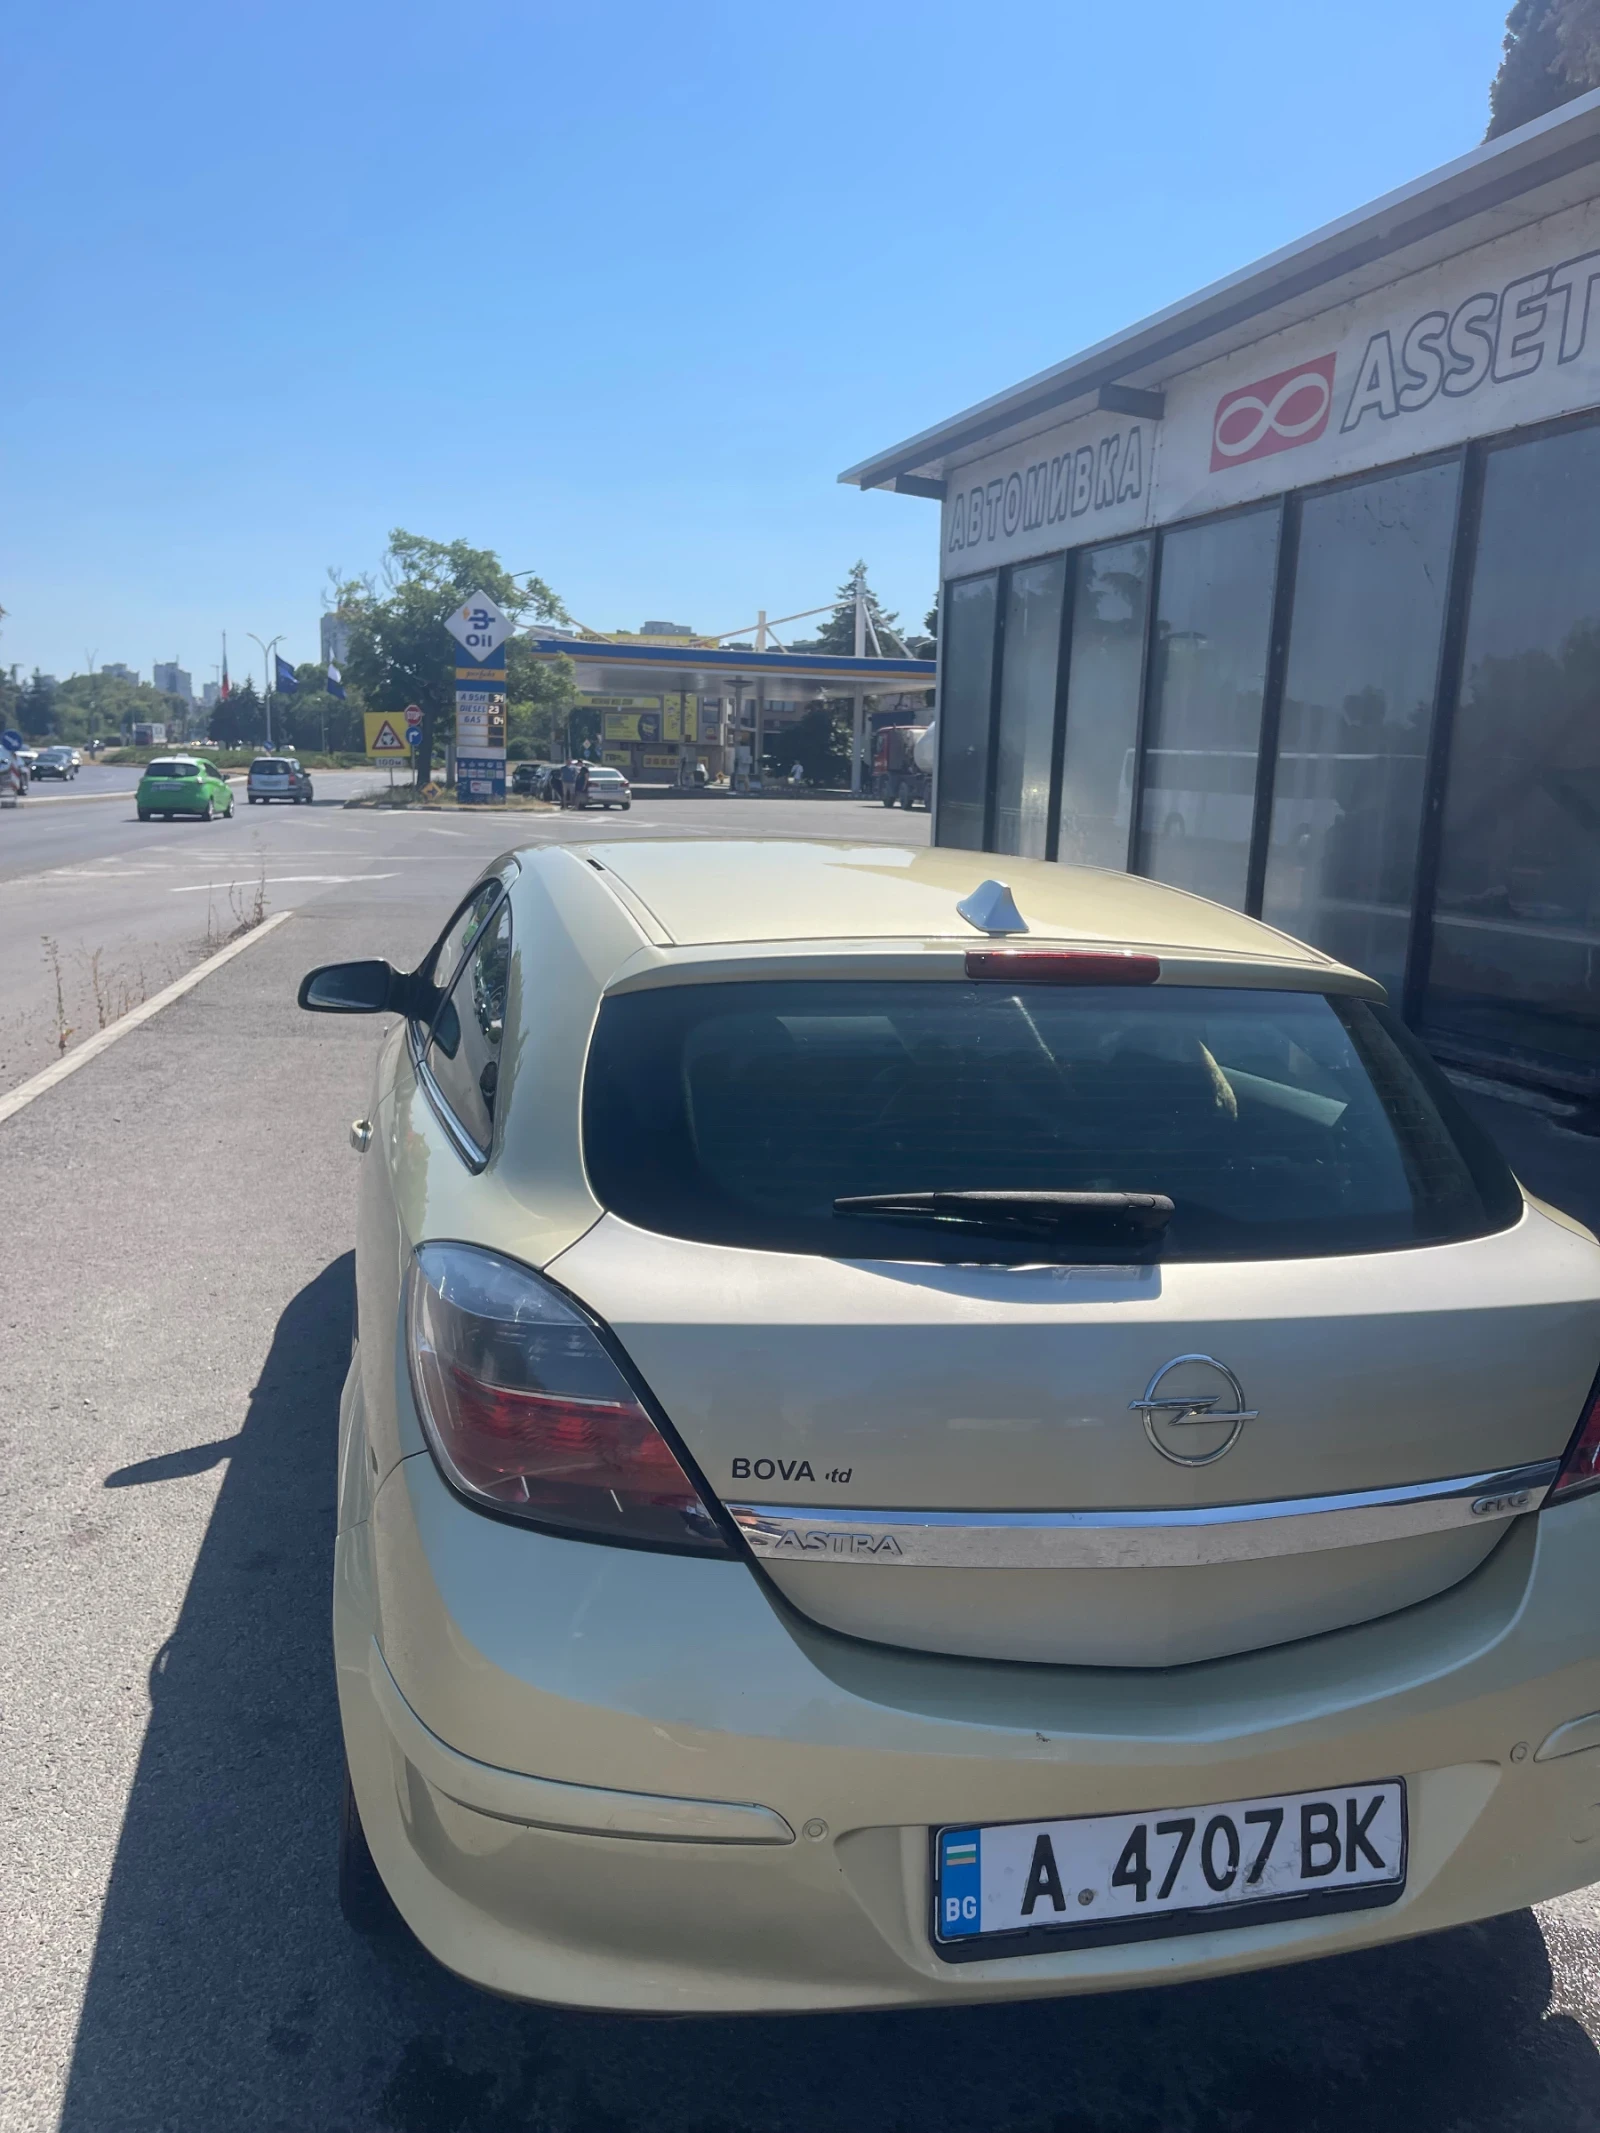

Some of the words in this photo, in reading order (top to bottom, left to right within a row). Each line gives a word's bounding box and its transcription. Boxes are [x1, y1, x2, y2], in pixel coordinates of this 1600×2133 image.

[1339, 248, 1600, 434] ASSET
[949, 425, 1142, 553] АВТОМИВКА
[465, 634, 492, 647] Oil
[460, 705, 487, 713] DIESEL
[731, 1457, 816, 1482] BOVA
[774, 1529, 903, 1555] ASTRA
[945, 1896, 977, 1922] BG
